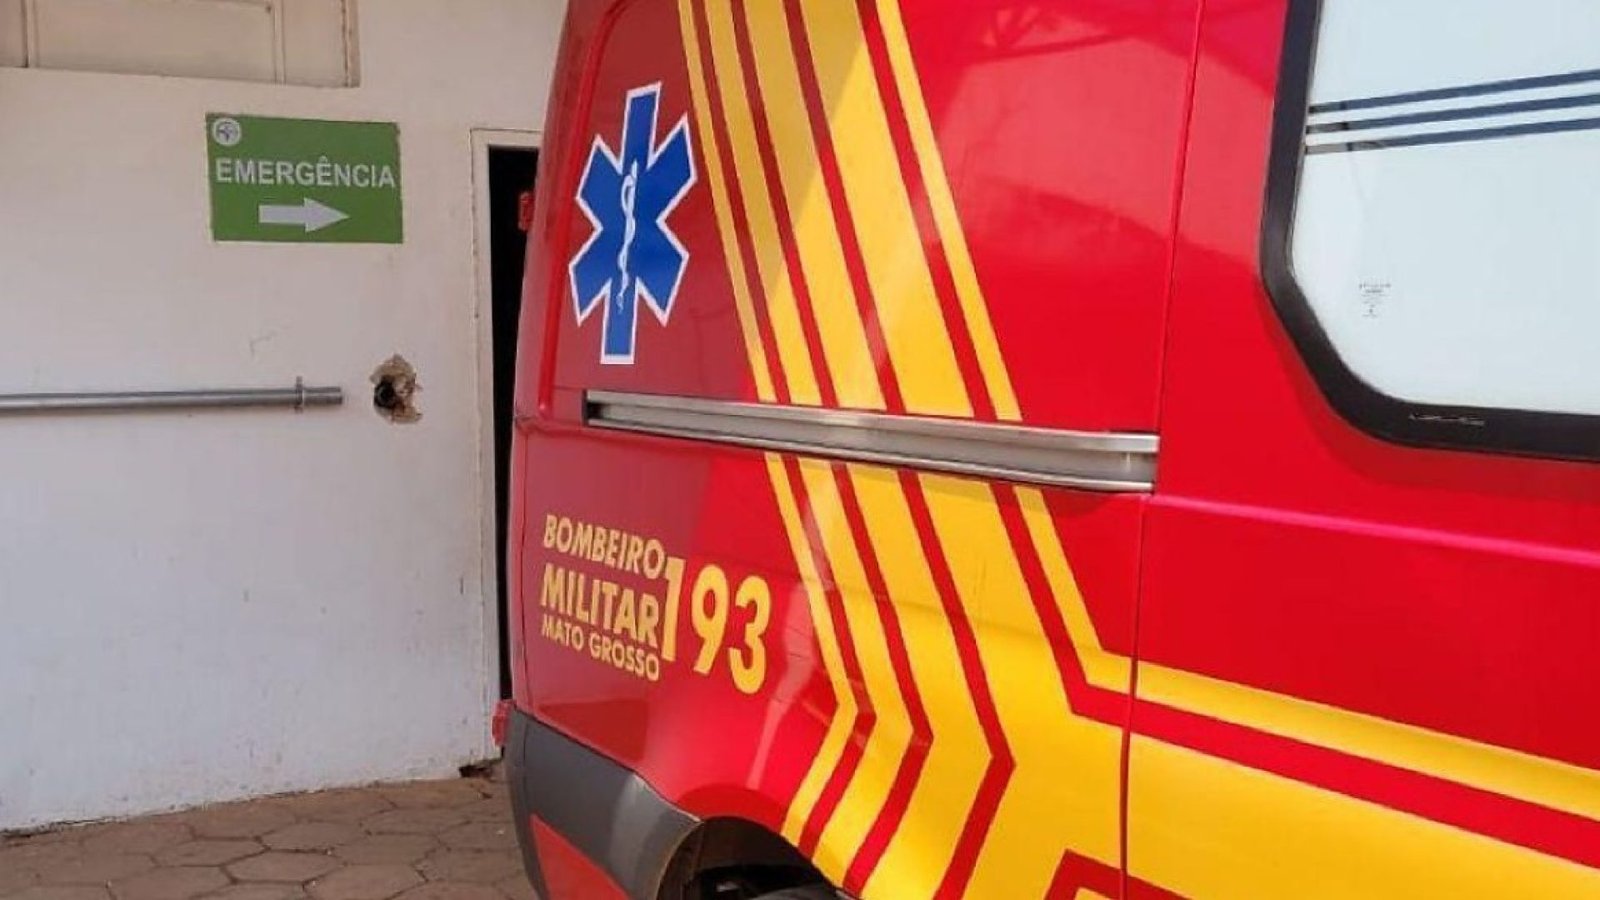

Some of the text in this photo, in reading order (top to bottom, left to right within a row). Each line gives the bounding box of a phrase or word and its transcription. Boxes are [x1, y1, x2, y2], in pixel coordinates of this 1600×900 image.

[215, 155, 396, 188] EMERGÊNCIA
[543, 514, 665, 579] BOMBEIRO
[541, 563, 660, 649] MILITAR
[661, 556, 771, 694] 193
[541, 613, 660, 681] MATO GROSSO
